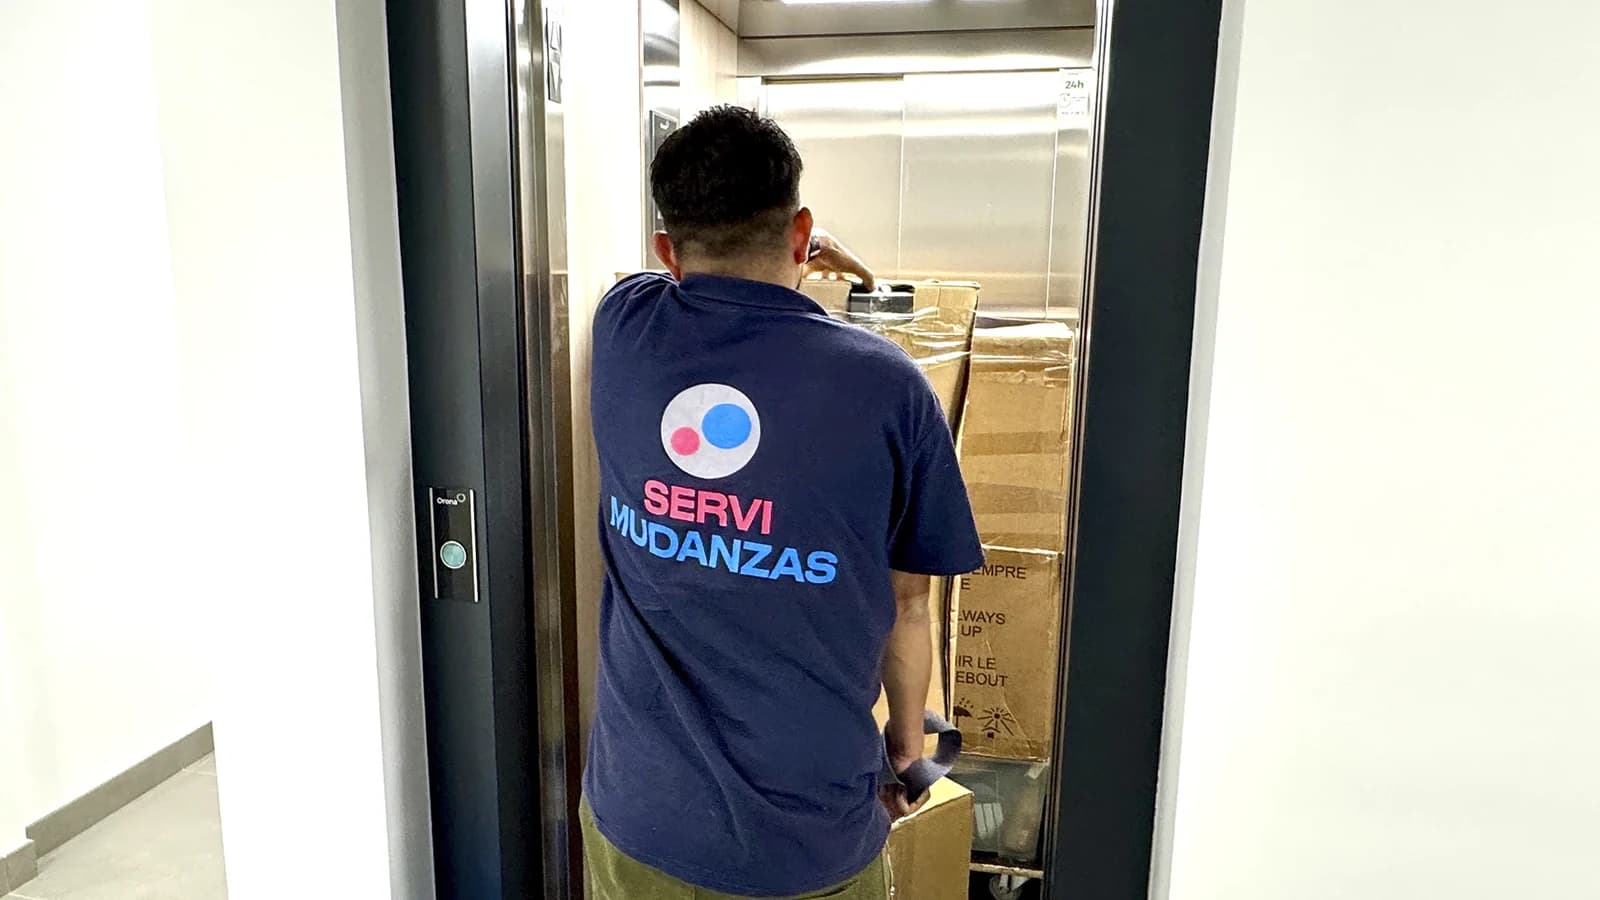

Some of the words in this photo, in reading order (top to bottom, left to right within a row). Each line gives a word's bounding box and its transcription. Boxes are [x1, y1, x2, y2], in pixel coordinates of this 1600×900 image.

[1065, 80, 1084, 89] 24h
[436, 497, 458, 506] Orona
[644, 480, 773, 534] SERVI
[609, 496, 838, 584] MUDANZAS
[961, 624, 982, 637] UP
[977, 657, 996, 670] LE
